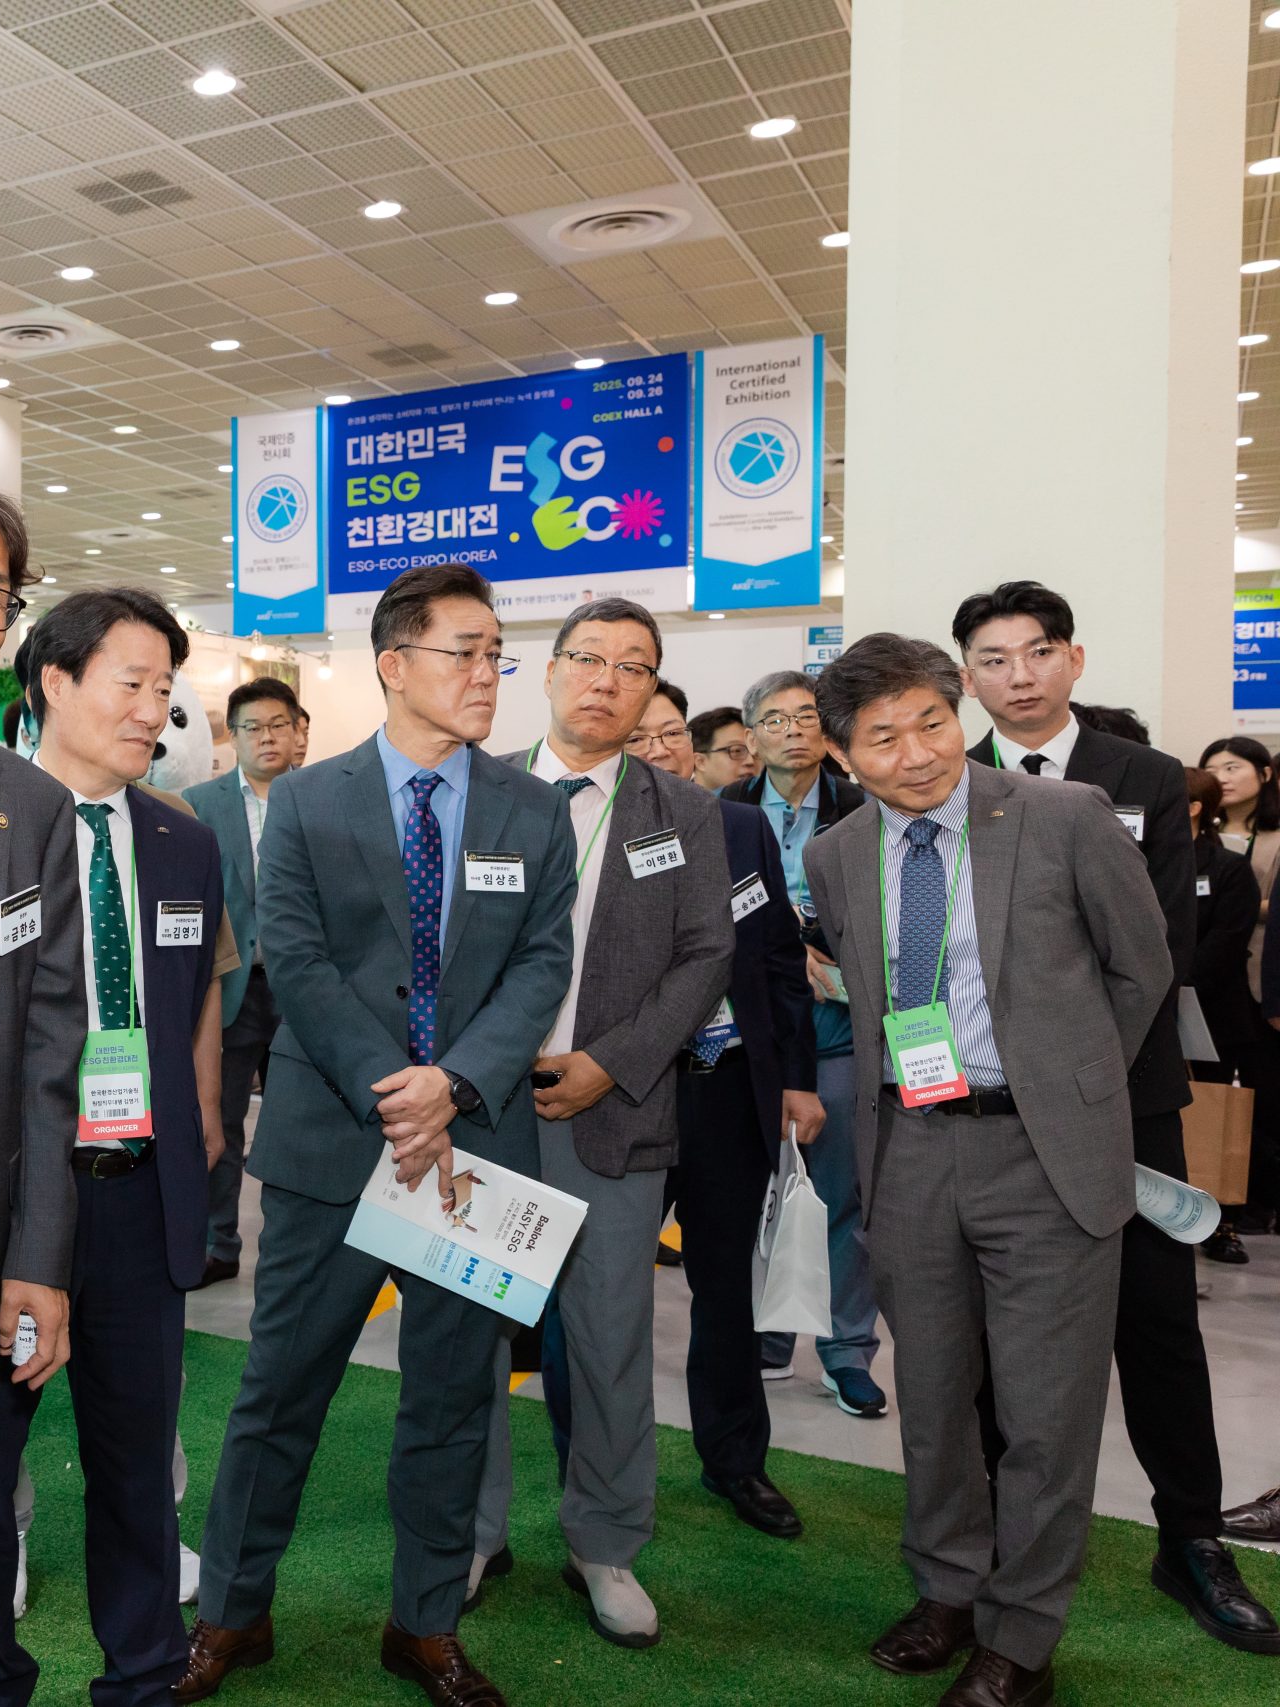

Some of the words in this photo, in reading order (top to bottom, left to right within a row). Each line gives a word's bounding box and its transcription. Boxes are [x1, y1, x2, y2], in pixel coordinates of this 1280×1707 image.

[716, 357, 801, 377] International
[648, 373, 663, 384] 24
[730, 374, 786, 390] Certified
[725, 388, 790, 405] Exhibition
[593, 410, 622, 423] COEX
[624, 407, 652, 419] HALL
[654, 405, 663, 415] A
[257, 432, 296, 446] 국제인증
[346, 422, 467, 466] 대한민국
[263, 447, 291, 461] 전시회
[346, 471, 421, 508] ESG
[346, 504, 499, 548] 친환경대전
[348, 556, 409, 573] ESG-ECO
[411, 553, 448, 568] EXPO
[450, 549, 498, 564] KOREA
[646, 851, 678, 868] 이명환
[483, 874, 518, 886] 임상준
[12, 918, 36, 942] 금한승
[173, 926, 198, 939] 김영기
[904, 1020, 929, 1031] 대한민국
[896, 1033, 911, 1041] ESG
[912, 1026, 943, 1038] 친환경대전
[95, 1045, 125, 1055] 대한민국
[83, 1057, 102, 1065] ESG
[102, 1054, 138, 1064] 친환경대전
[906, 1054, 947, 1068] 한국환경산업기술원
[90, 1087, 139, 1097] 한국환경산업기술원
[915, 1087, 956, 1100] ORGANIZER
[93, 1124, 139, 1134] ORGANIZER
[519, 1201, 538, 1230] EASY
[525, 1215, 549, 1251] Baslock
[507, 1229, 525, 1253] ESG
